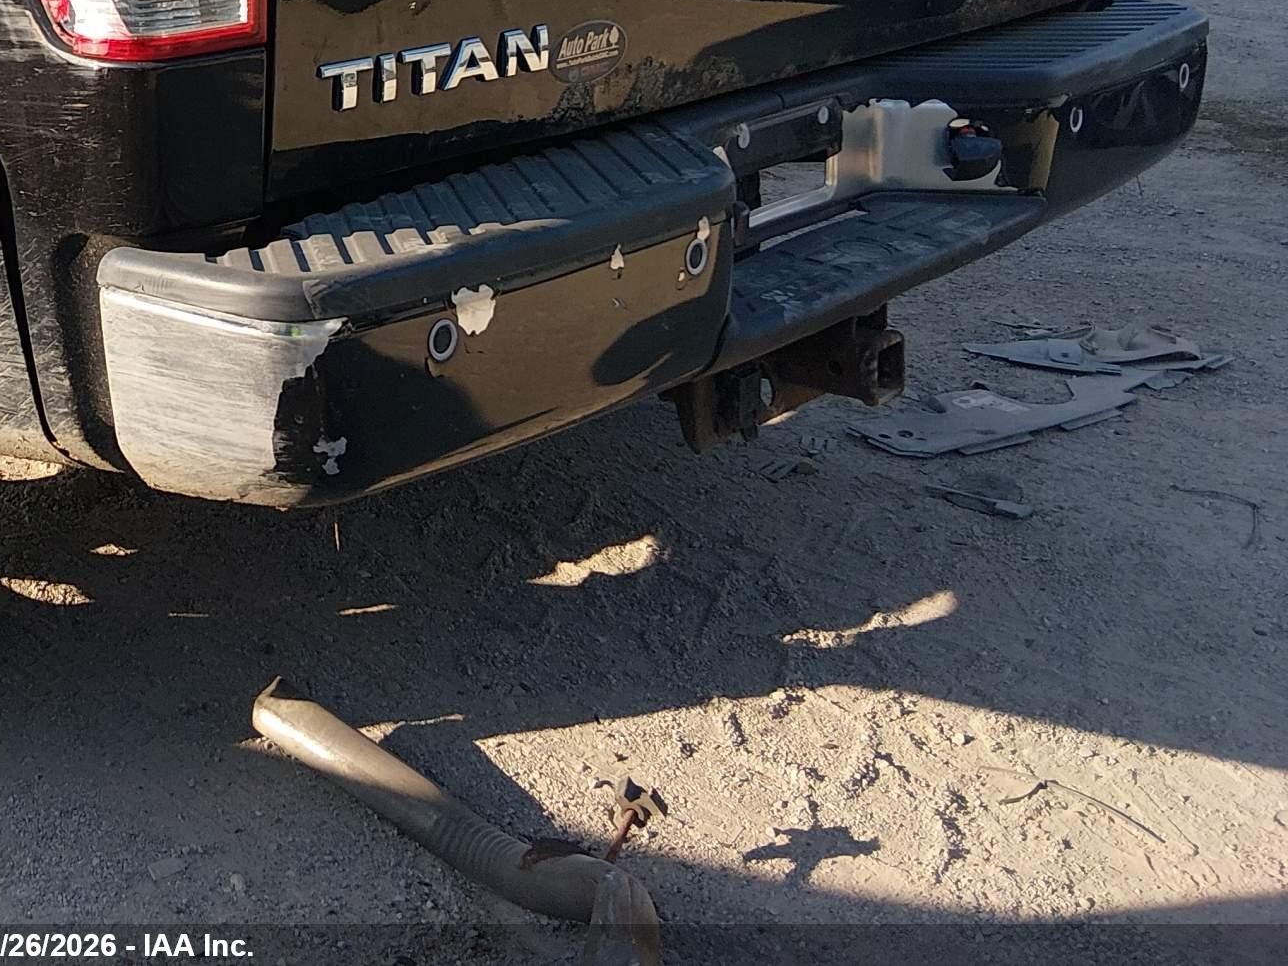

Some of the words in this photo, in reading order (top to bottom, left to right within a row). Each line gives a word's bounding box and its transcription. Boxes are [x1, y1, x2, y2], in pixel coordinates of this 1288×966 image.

[316, 24, 550, 112] TITAN
[558, 37, 585, 59] Auto
[584, 27, 610, 53] Park
